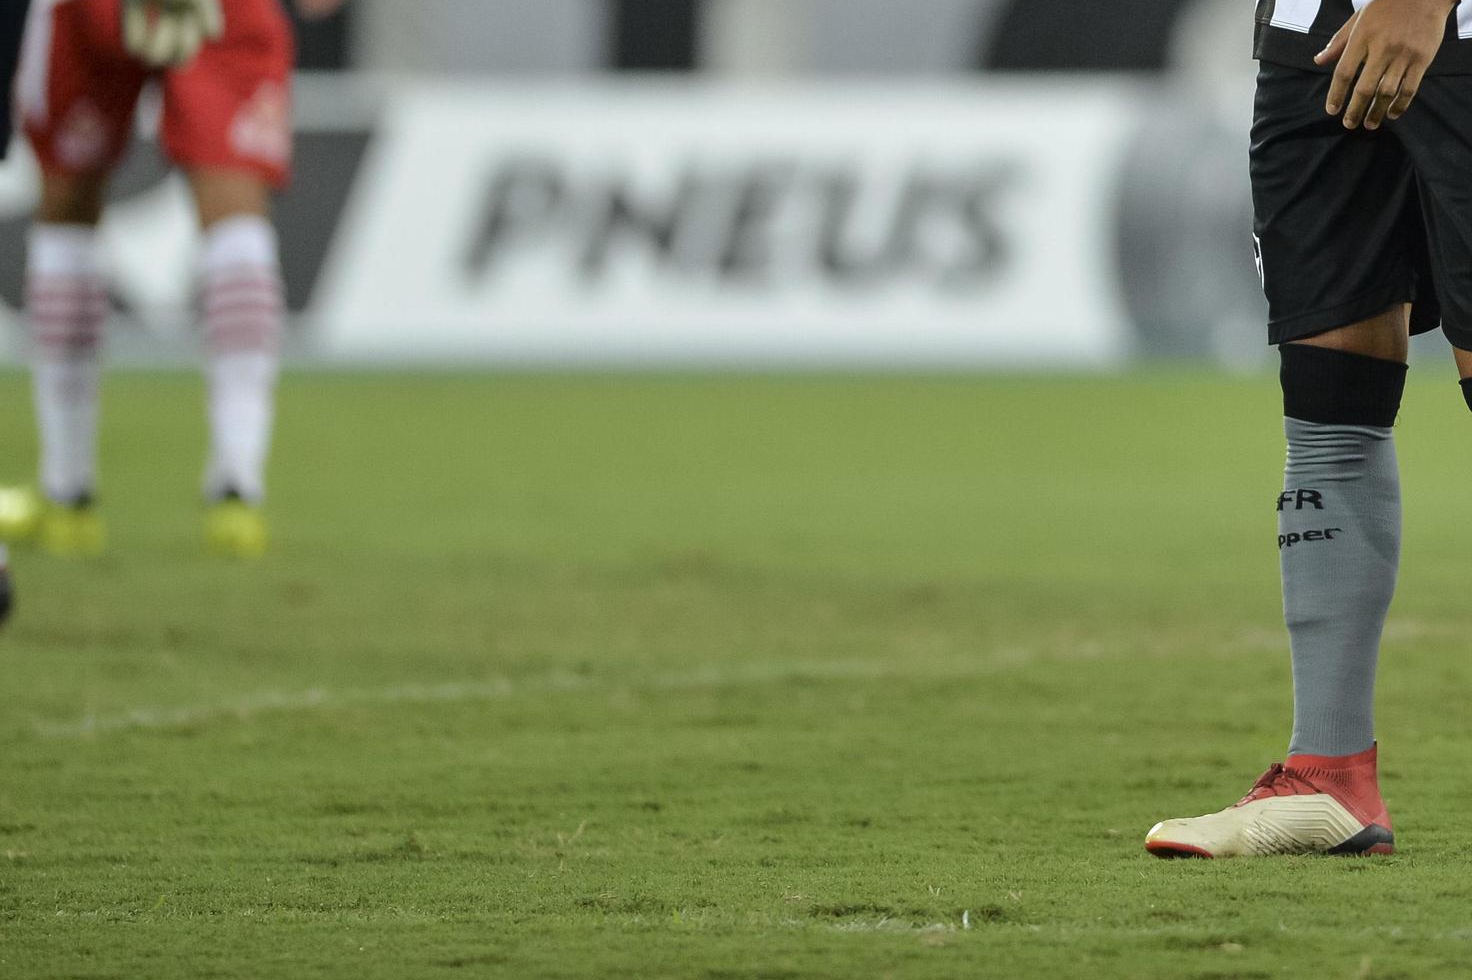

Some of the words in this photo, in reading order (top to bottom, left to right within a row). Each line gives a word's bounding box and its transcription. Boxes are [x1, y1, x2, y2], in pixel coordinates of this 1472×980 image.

[455, 145, 1035, 297] PNEUS
[1276, 488, 1325, 512] FR
[1277, 527, 1343, 550] pper
